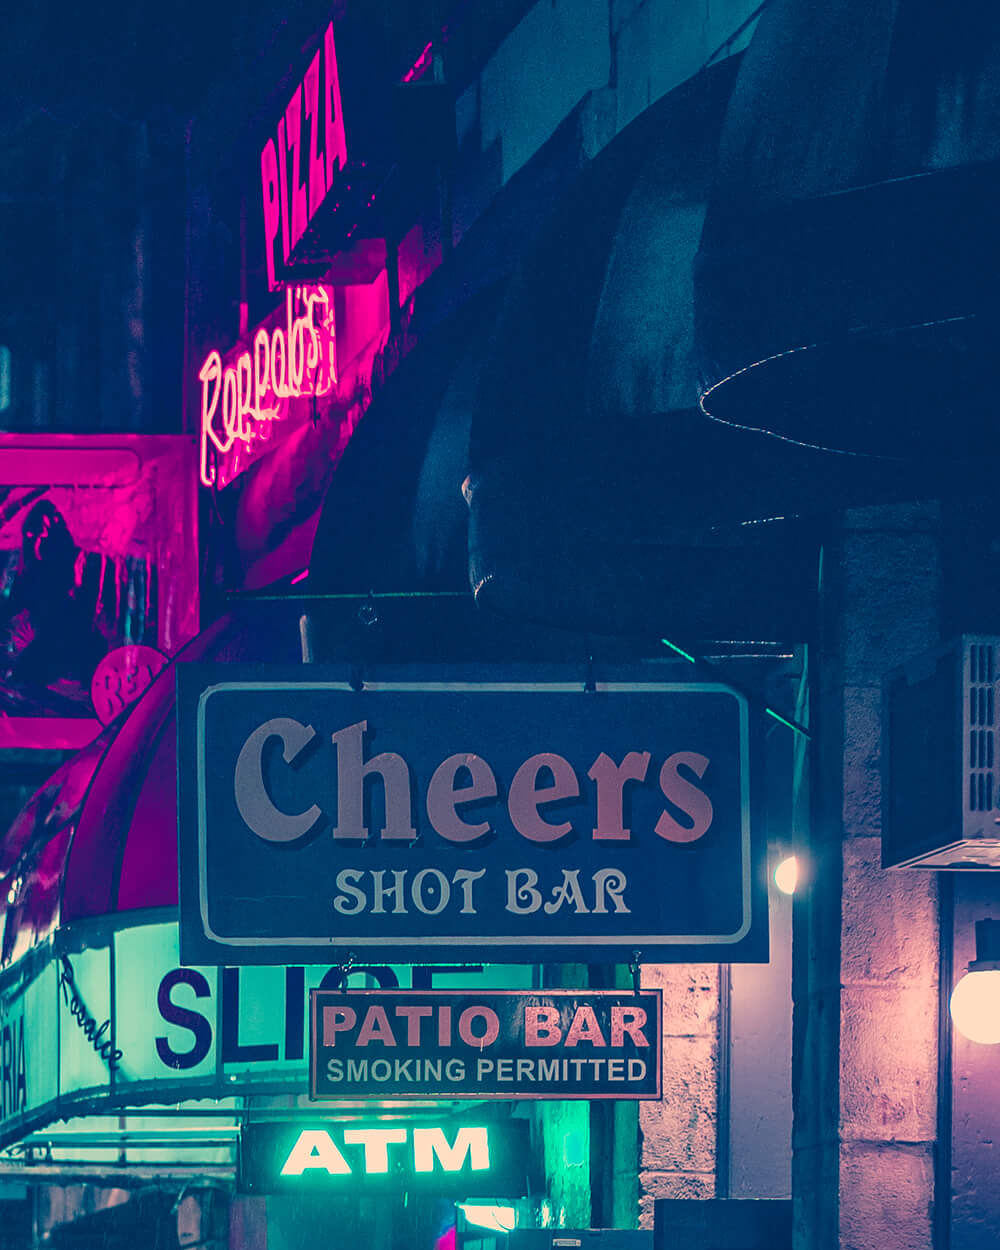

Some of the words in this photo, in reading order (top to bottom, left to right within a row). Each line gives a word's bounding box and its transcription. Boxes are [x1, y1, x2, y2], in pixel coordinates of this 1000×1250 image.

[261, 21, 347, 291] PIZZA
[234, 717, 714, 843] Cheers
[333, 868, 487, 915] SHOT
[505, 868, 631, 914] BAR
[154, 966, 484, 1070] SLI
[323, 1005, 500, 1048] PATIO
[525, 1005, 650, 1048] BAR
[327, 1058, 466, 1082] SMOKING
[476, 1058, 648, 1082] PERMITTED
[280, 1126, 490, 1176] ATM
